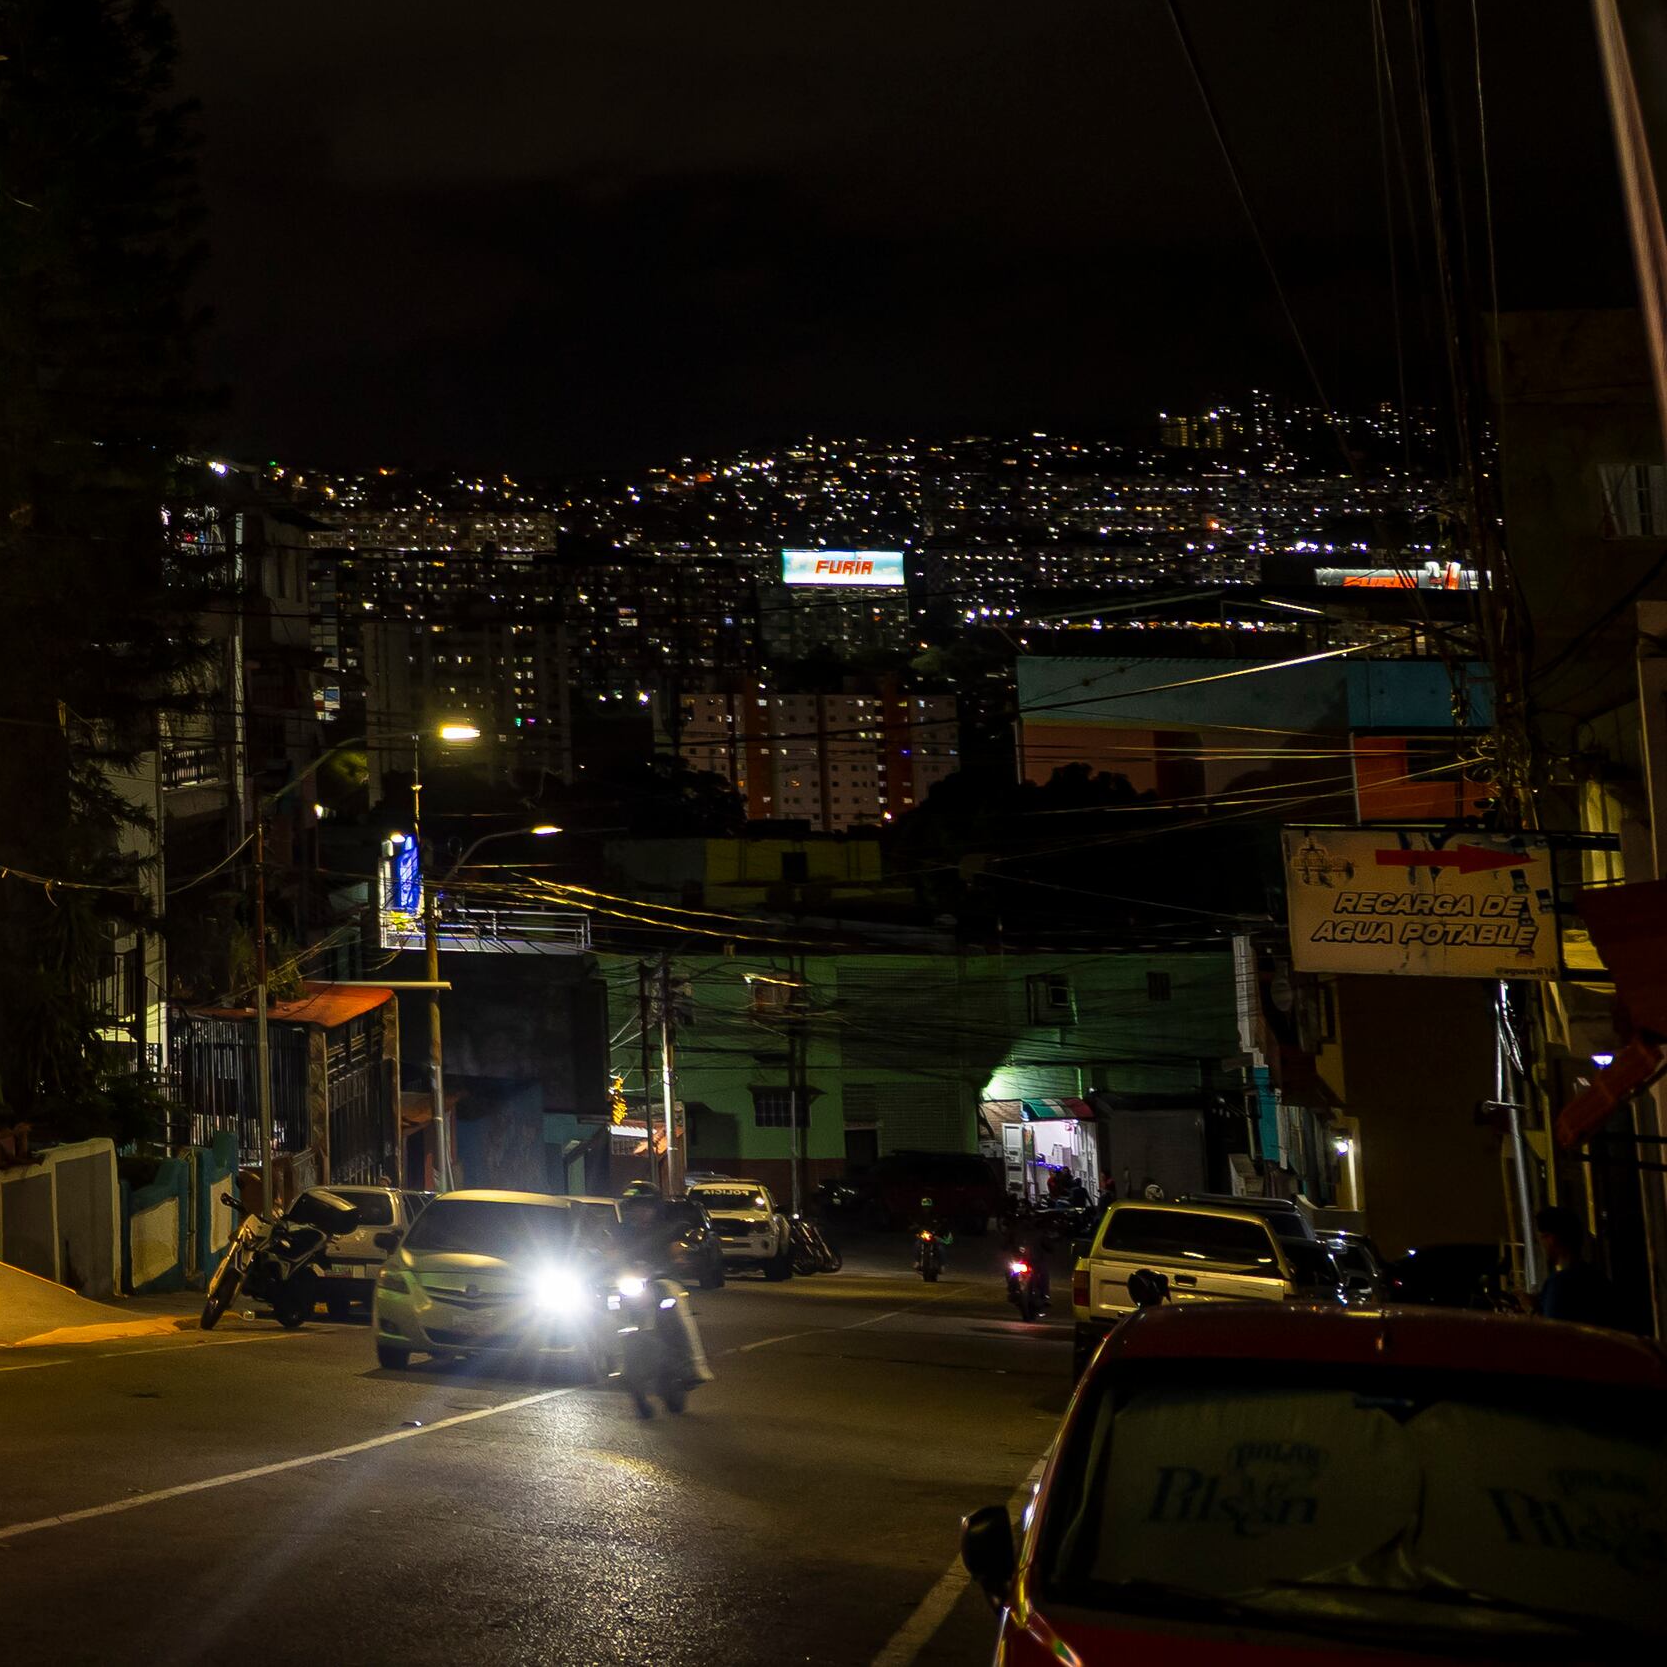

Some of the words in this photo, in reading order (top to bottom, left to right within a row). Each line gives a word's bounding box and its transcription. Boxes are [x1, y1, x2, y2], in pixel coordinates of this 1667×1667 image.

[1333, 892, 1473, 917] RECARGA
[1480, 895, 1528, 918] DE
[1311, 920, 1393, 943] AGUA
[1400, 923, 1538, 947] POTABLE
